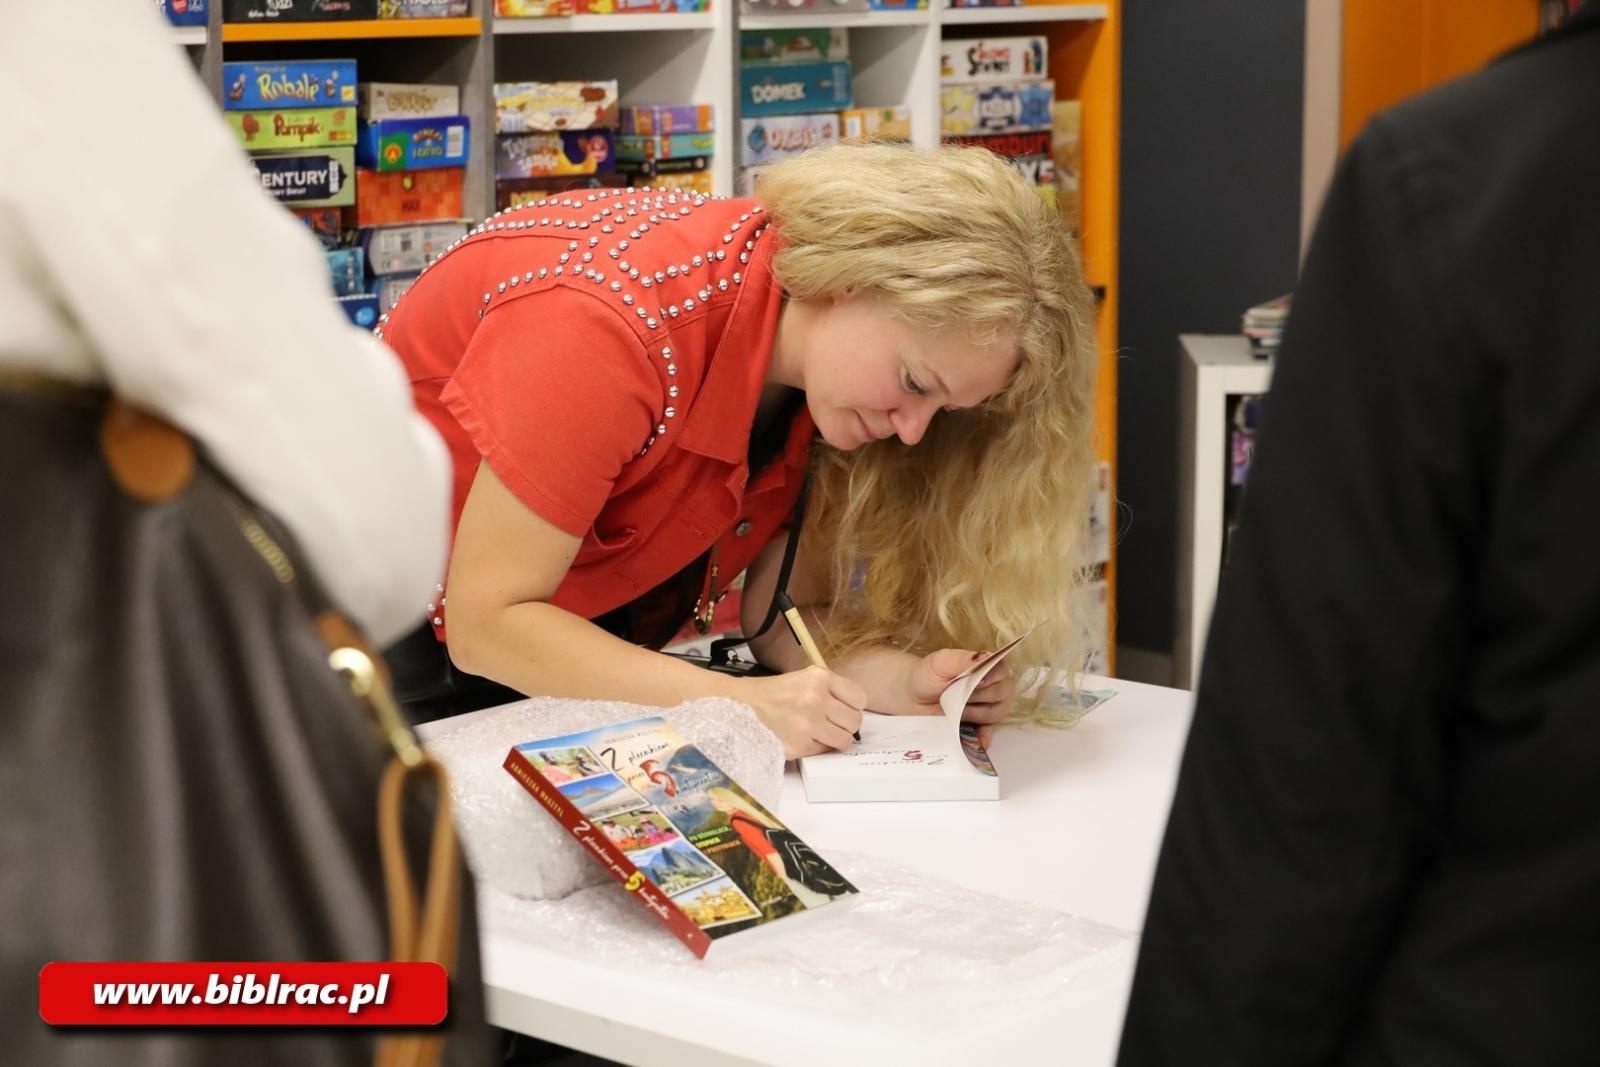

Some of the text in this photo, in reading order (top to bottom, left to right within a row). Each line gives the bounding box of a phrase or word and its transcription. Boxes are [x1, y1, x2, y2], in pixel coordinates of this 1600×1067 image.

[751, 82, 806, 104] DOMEK
[260, 169, 329, 188] ENTURY
[640, 759, 677, 798] 5
[622, 870, 646, 893] 5
